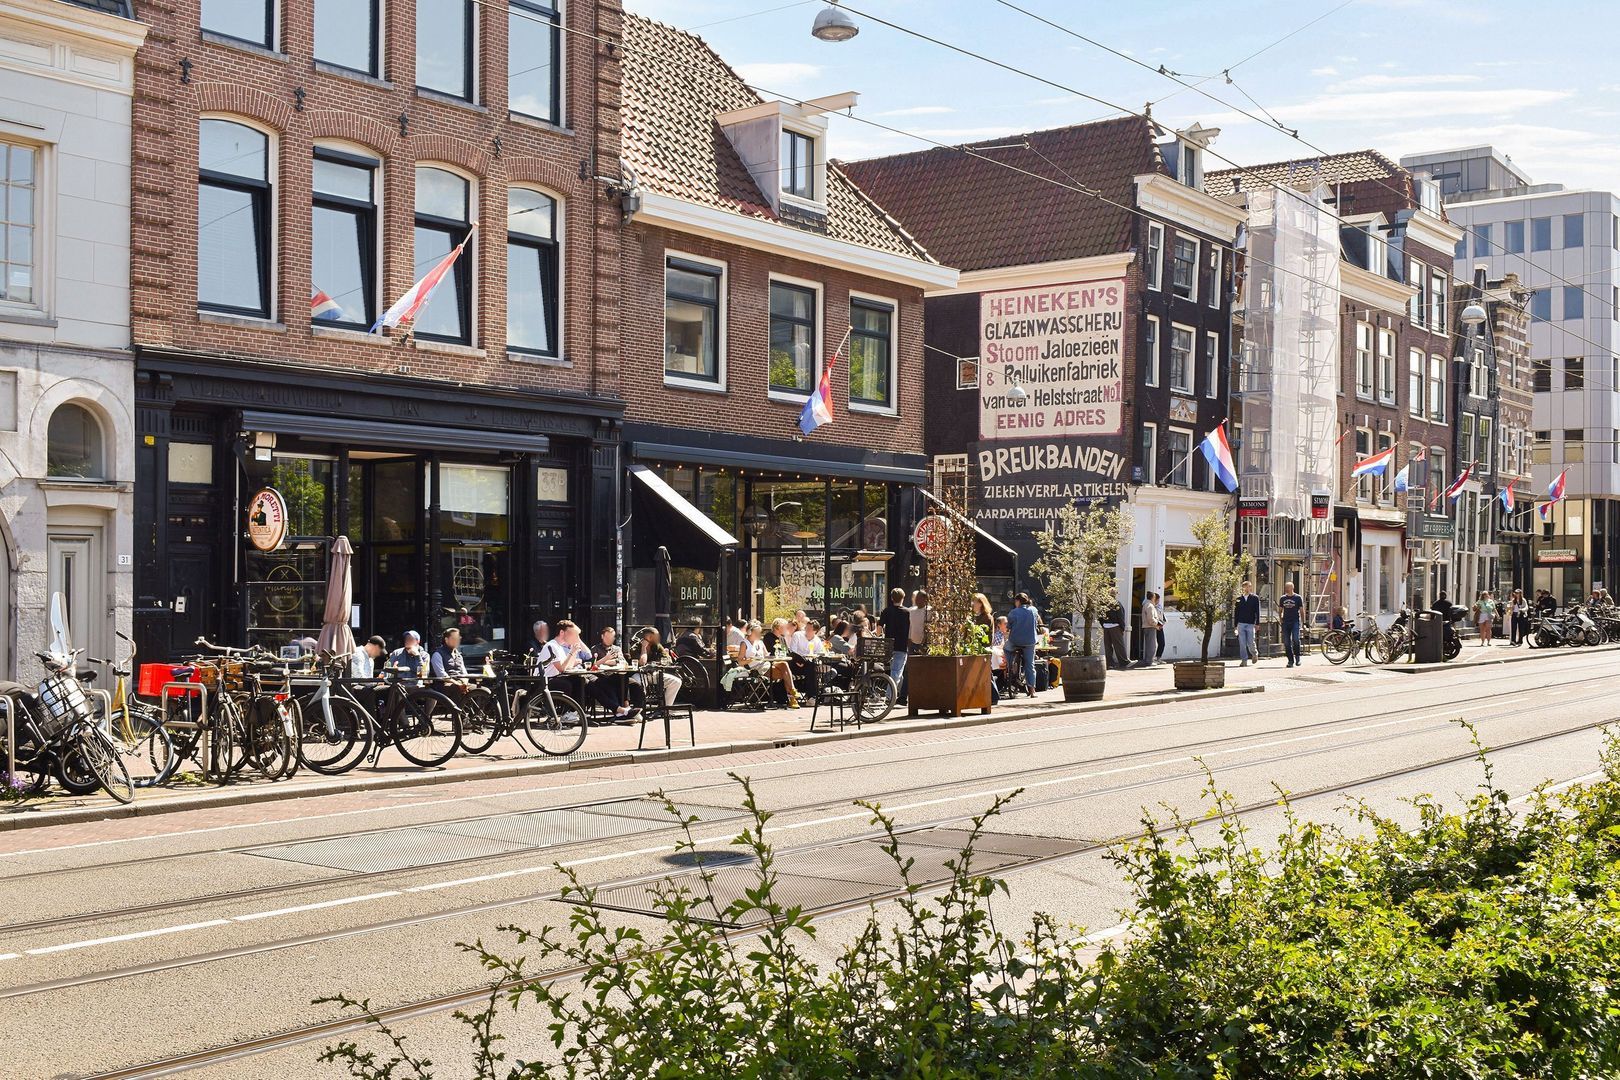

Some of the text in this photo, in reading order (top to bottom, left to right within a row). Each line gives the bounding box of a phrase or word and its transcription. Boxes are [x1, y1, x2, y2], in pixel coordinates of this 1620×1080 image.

[989, 286, 1118, 317] HEINEKEN'S
[985, 311, 1122, 341] GLAZENWASSCHERIJ
[986, 343, 1039, 364] Stoom
[986, 358, 1119, 387] & Rolluikenfabriek
[1034, 385, 1103, 407] Helststraat
[997, 409, 1106, 430] EENIG ADRES
[978, 444, 1125, 482] BREUKBANDEN
[262, 493, 280, 523] MORETTI
[975, 507, 1078, 520] AARDAPPELHAN
[681, 584, 712, 600] BAR DÓ
